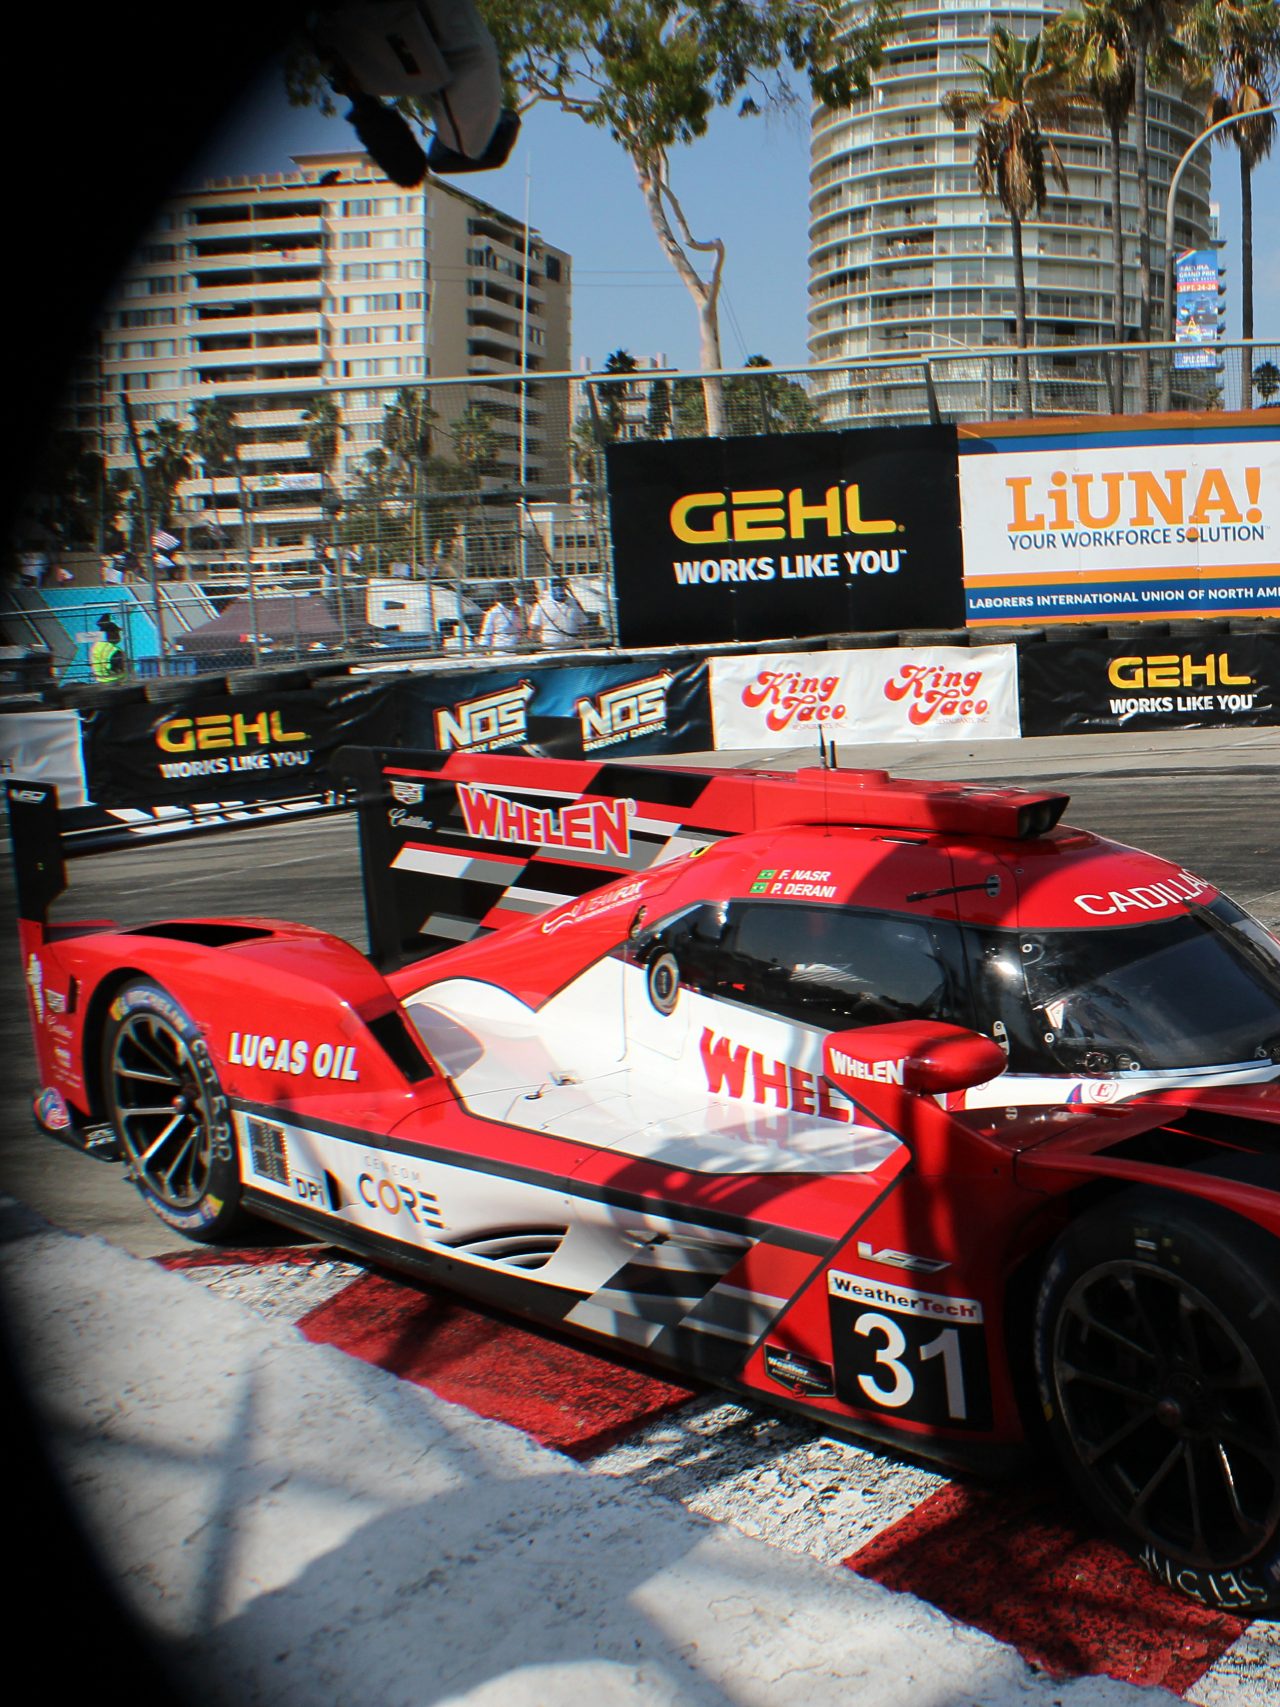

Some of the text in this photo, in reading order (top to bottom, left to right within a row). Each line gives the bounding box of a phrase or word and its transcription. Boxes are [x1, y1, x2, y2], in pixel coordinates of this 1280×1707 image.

[669, 483, 897, 545] GEHL
[1005, 466, 1263, 533] LiUNA!
[1008, 525, 1265, 551] YOUR WORKFORCE SOLUTION
[673, 549, 901, 585] WORKS LIKE YOU
[969, 594, 1034, 609] LABORERS
[1036, 590, 1139, 607] INTERNATIONAL
[1141, 588, 1184, 603] UNION
[1188, 588, 1206, 601] OF
[1208, 586, 1254, 600] NORTH
[741, 670, 840, 708] King
[884, 664, 982, 701] King
[1108, 653, 1252, 689] GEHL
[434, 681, 535, 751] NOS
[576, 669, 674, 743] NOS
[765, 694, 847, 732] Taco
[908, 689, 989, 726] Taco
[1110, 693, 1253, 714] WORKS LIKE YOU
[156, 710, 307, 753] GEHL
[489, 732, 528, 750] DRINK
[583, 721, 667, 752] ENERGY DRINK
[159, 750, 311, 780] WORKS LIKE YOU
[456, 782, 631, 858] WHELEN
[770, 882, 838, 898] P. DERANI
[778, 869, 832, 882] F. NASR
[228, 1032, 359, 1082] LUCAS OIL
[828, 1047, 906, 1086] WHELEN
[700, 1026, 857, 1127] WHEL
[358, 1172, 446, 1229] CORE
[832, 1276, 975, 1319] WeatherTech
[854, 1312, 967, 1420] 31
